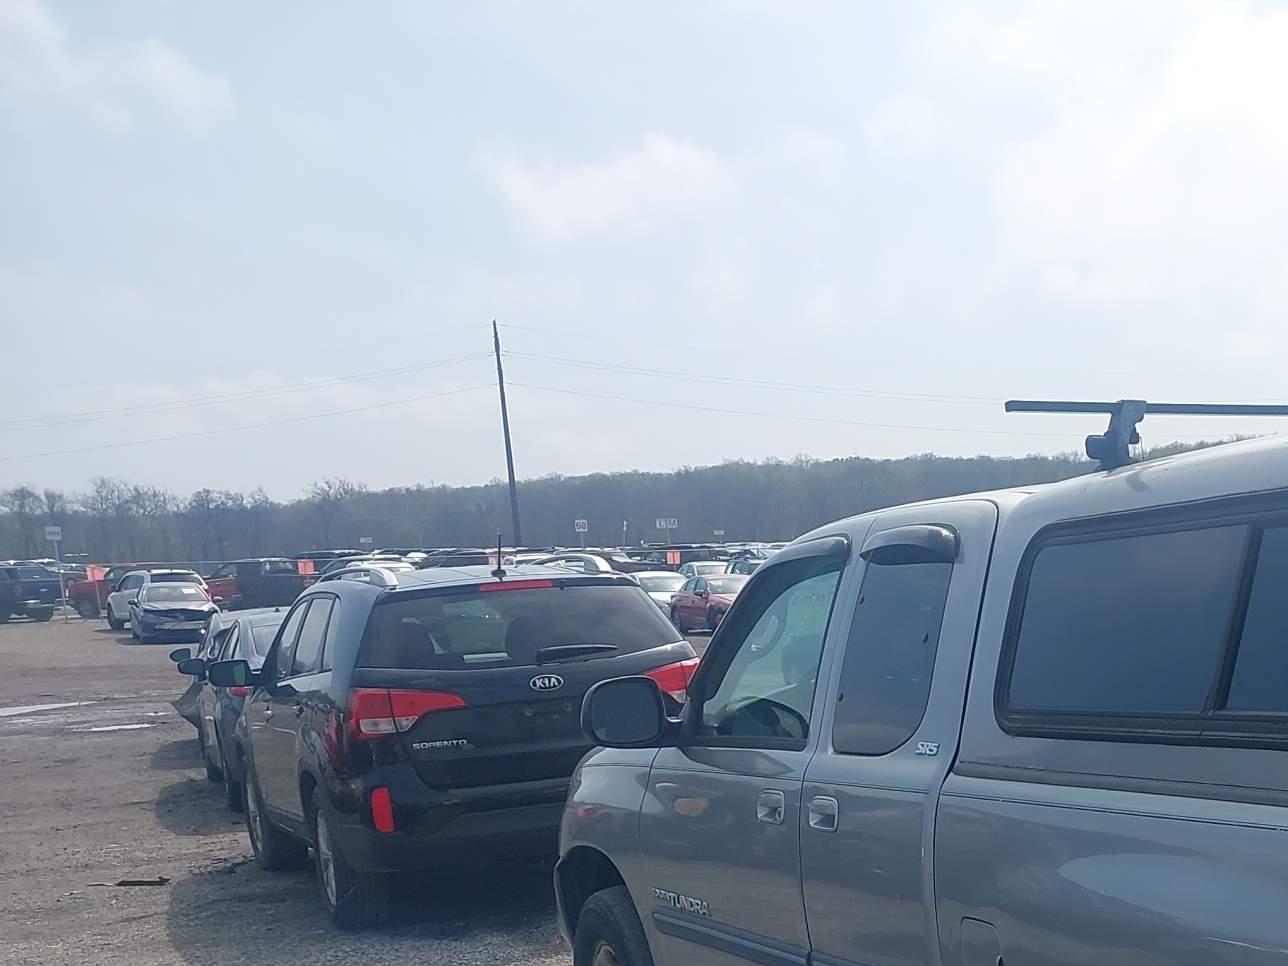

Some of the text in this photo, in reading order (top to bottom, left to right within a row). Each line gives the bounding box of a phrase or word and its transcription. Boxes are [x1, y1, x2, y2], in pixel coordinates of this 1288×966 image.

[535, 677, 559, 688] KIA
[412, 739, 467, 750] SORENTO
[669, 892, 711, 917] TUNDRA
